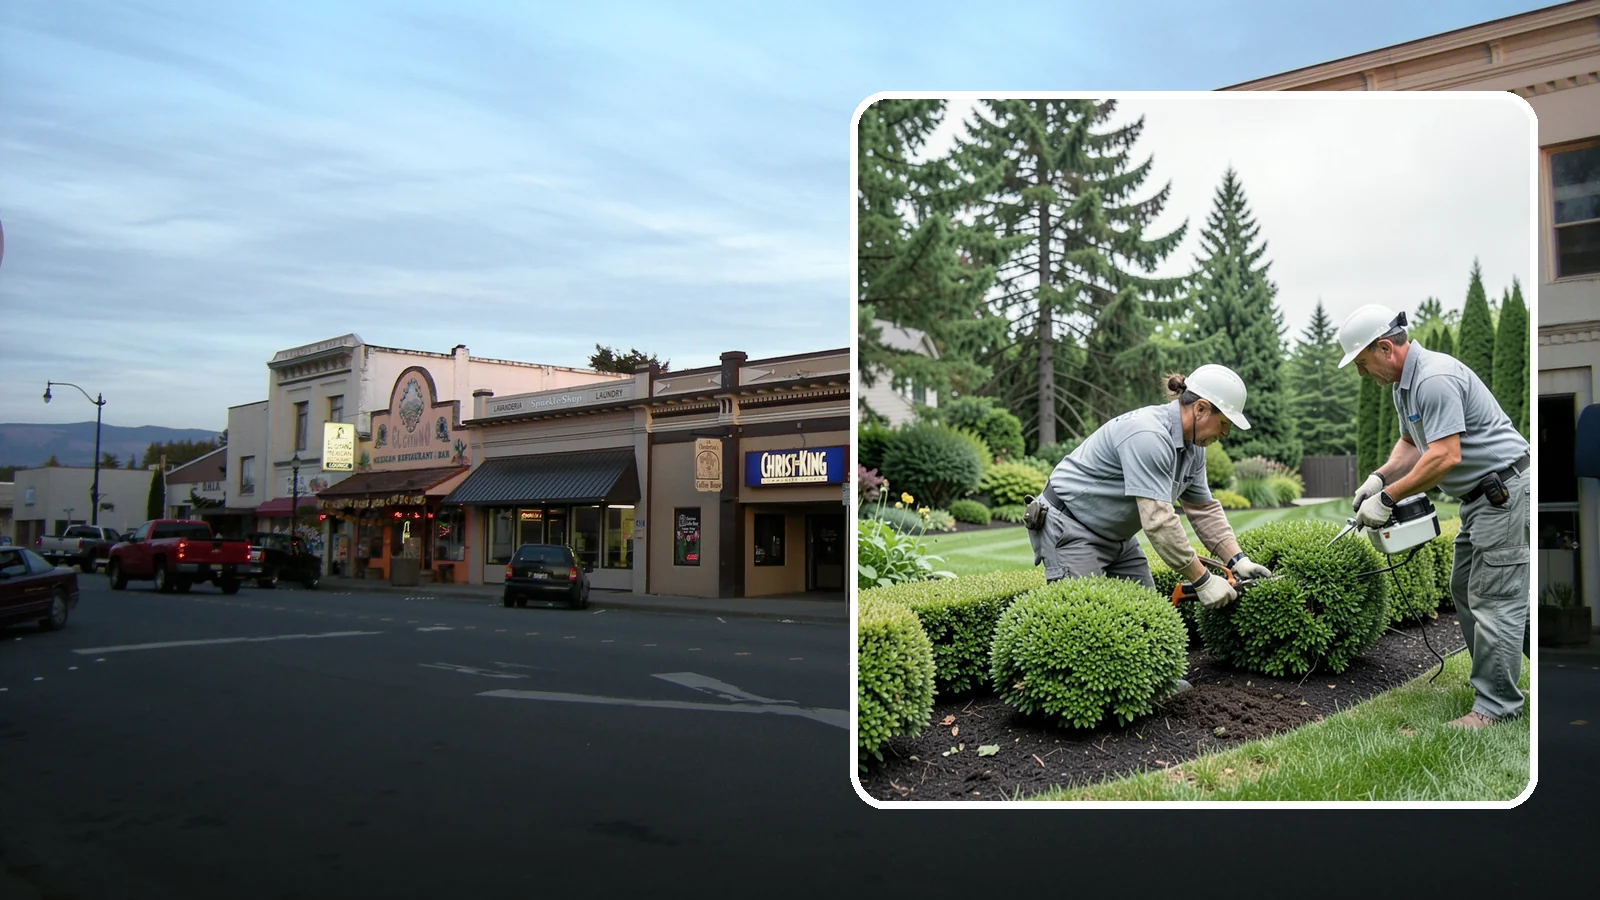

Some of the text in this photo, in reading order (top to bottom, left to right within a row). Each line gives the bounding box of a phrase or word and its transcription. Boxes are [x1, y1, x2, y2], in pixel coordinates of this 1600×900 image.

[595, 389, 623, 400] LAUNDRY
[493, 402, 522, 413] LAVANDERIA
[531, 394, 583, 410] Sparkle Shop
[397, 451, 433, 462] RESTAURANT
[438, 450, 450, 459] BAR
